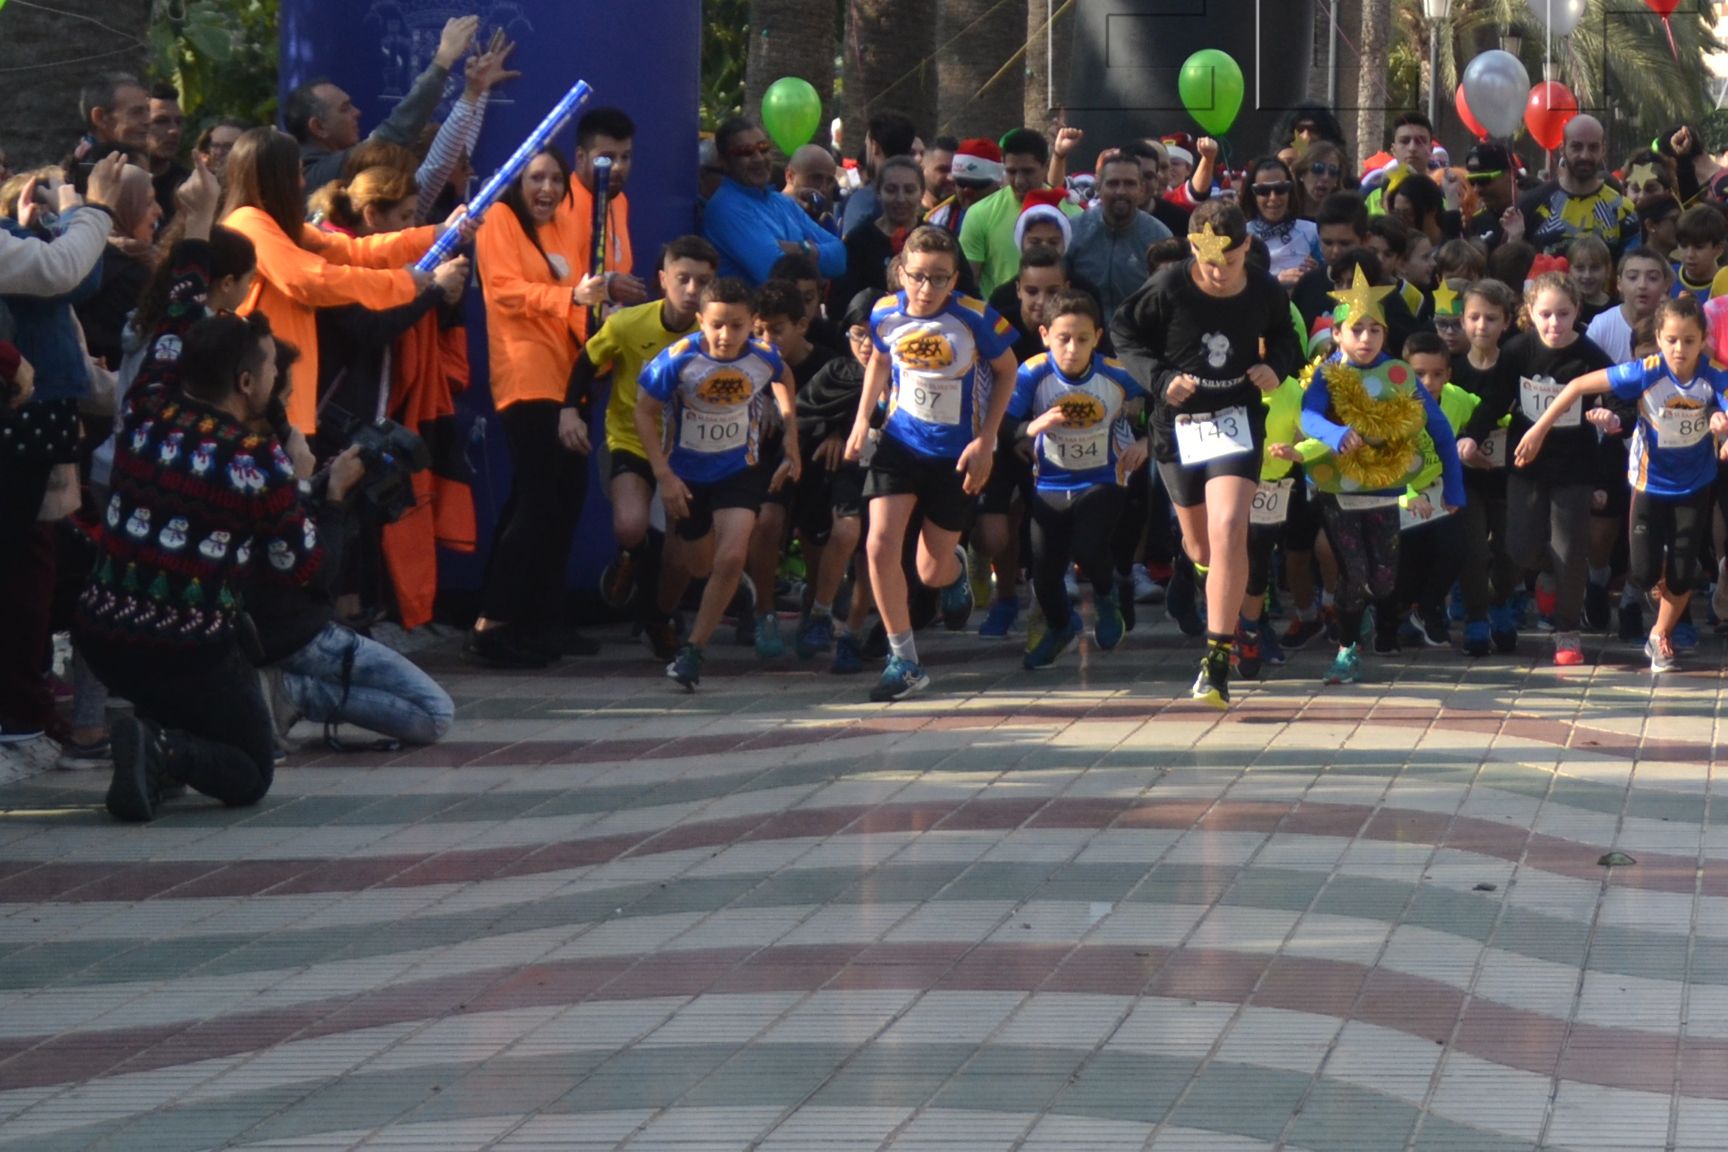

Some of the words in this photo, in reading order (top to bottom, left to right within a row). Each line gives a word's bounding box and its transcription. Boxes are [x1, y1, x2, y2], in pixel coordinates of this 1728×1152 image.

[914, 388, 942, 409] 97
[697, 421, 739, 442] 100
[1194, 416, 1239, 443] 143
[1679, 418, 1707, 436] 86
[1057, 440, 1098, 459] 134
